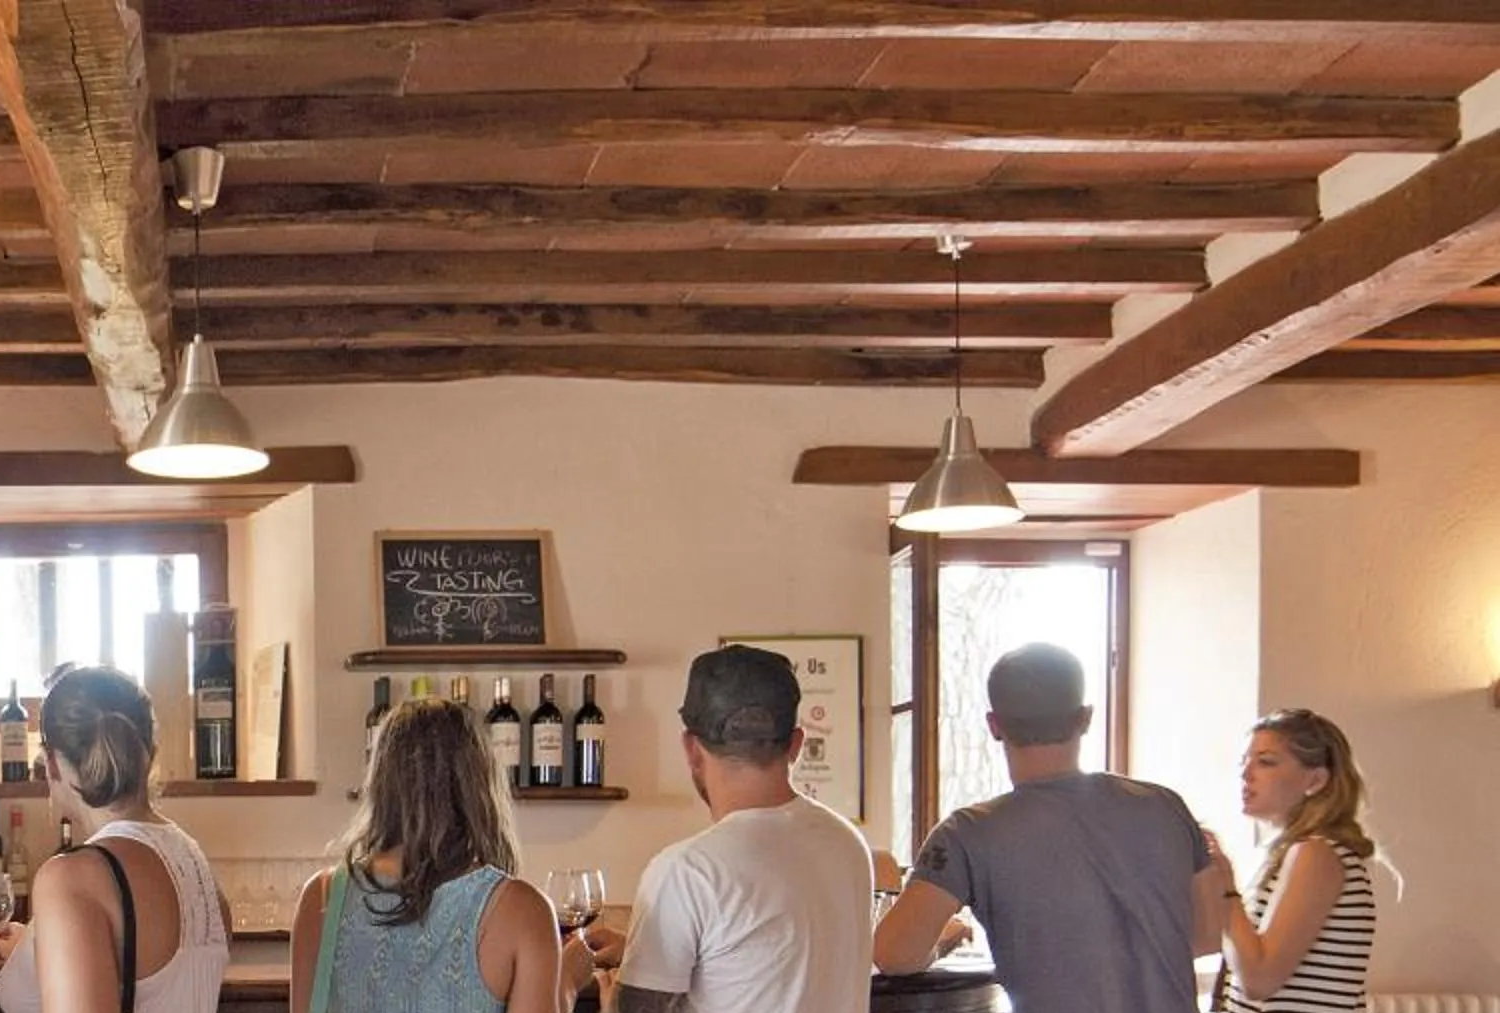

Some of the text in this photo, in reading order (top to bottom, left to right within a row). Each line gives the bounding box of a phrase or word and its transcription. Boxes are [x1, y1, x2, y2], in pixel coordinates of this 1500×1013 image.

[397, 545, 453, 569] WINE
[430, 569, 524, 591] TASTING
[807, 657, 827, 674] Us
